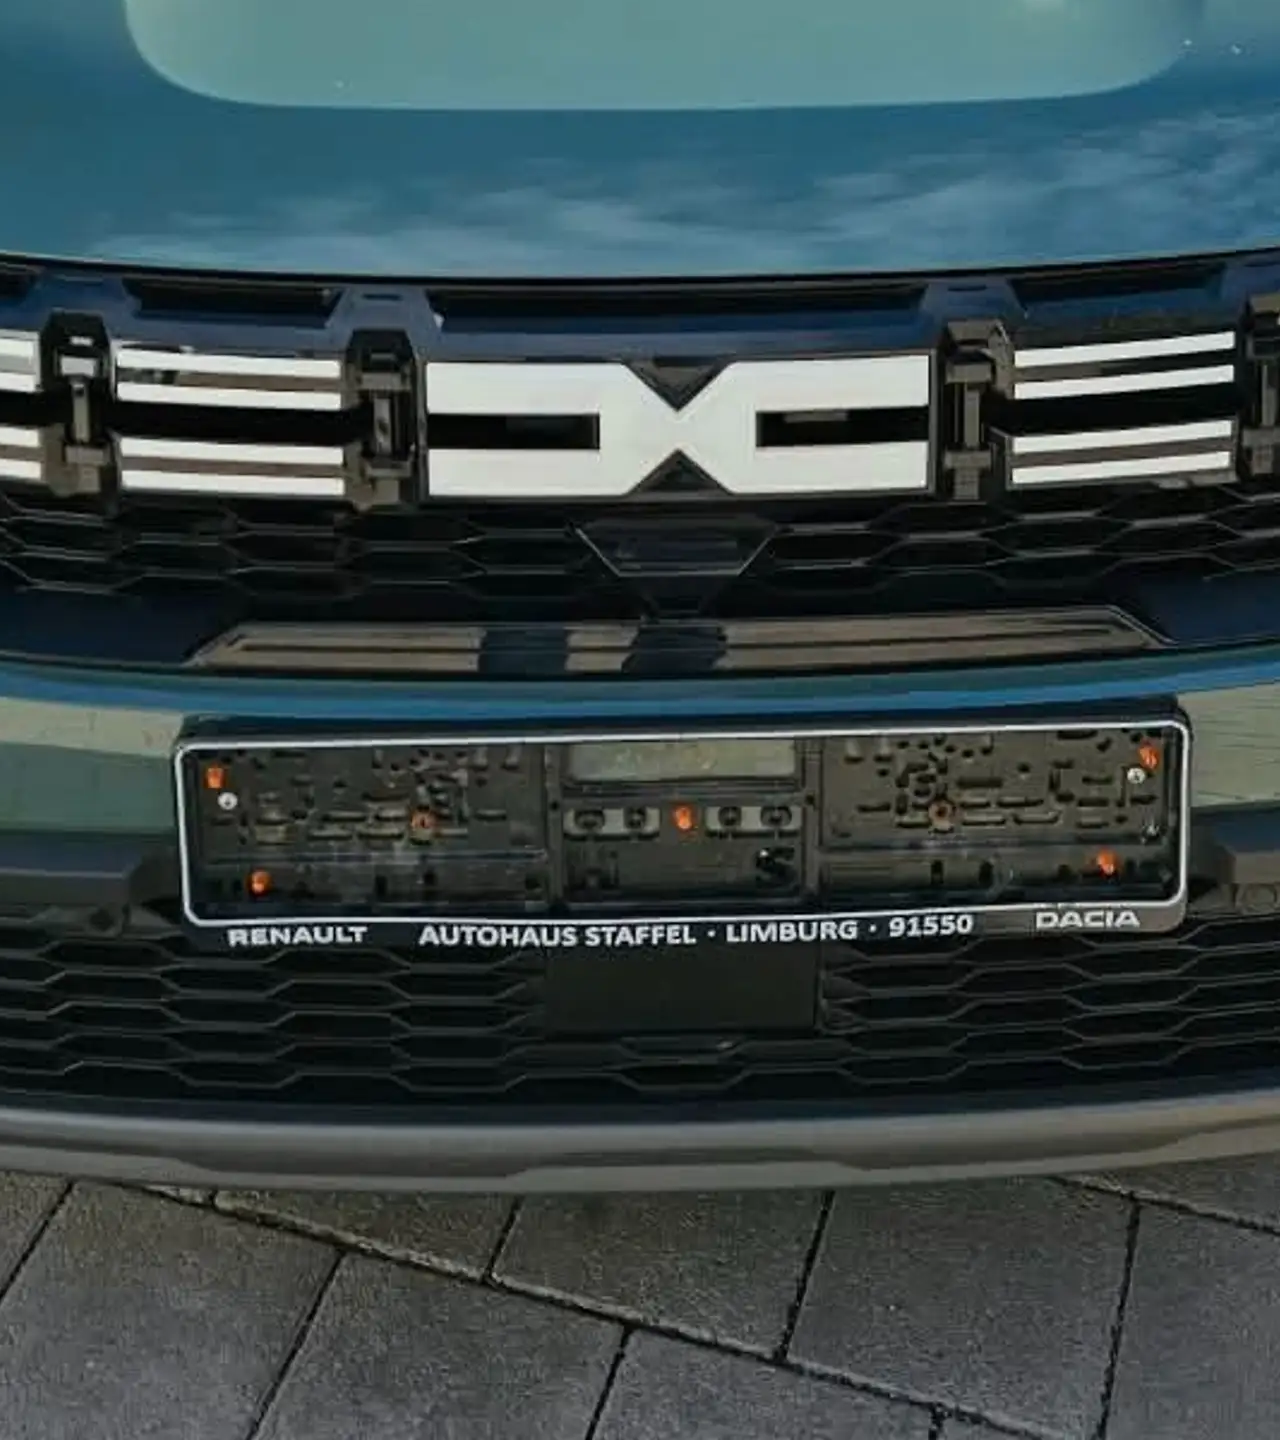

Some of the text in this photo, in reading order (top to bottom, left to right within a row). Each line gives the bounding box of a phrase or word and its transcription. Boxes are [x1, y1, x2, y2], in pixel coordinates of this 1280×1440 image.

[1035, 909, 1140, 929] DACIA
[227, 926, 368, 947] RENAULT
[419, 914, 973, 947] AUTOHAUS STAFFEL LIMBURG 91550
